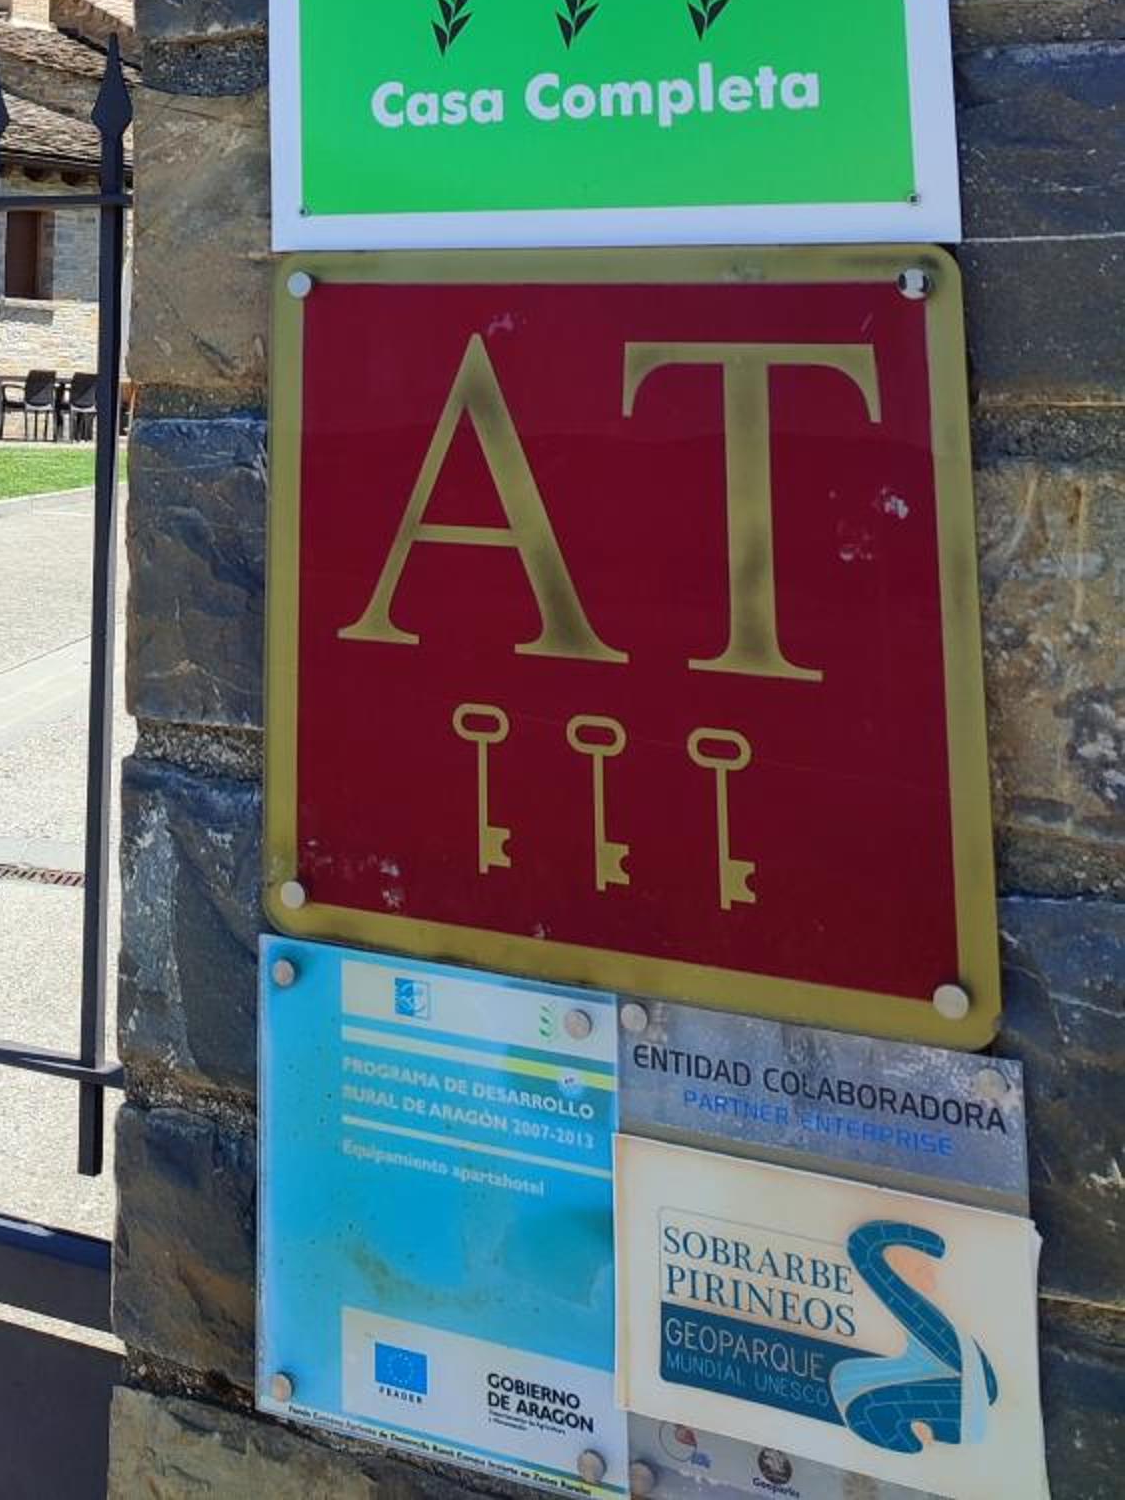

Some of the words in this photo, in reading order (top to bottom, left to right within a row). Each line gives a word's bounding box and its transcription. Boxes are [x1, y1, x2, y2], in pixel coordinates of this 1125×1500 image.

[371, 82, 504, 128] Casa
[525, 62, 820, 127] Completa
[337, 333, 882, 682] AT
[342, 1055, 441, 1091] PROGRAMA
[444, 1076, 468, 1097] DE
[472, 1082, 595, 1120] DESARROLLO
[342, 1085, 398, 1109] RURAL
[402, 1096, 426, 1115] DE
[512, 1118, 594, 1149] 2007-2013
[634, 1044, 752, 1087] ENTIDAD
[763, 1067, 1006, 1134] COLABORADORA
[684, 1090, 789, 1125] PARTNER
[801, 1113, 954, 1156] ENTERPRISE
[342, 1138, 448, 1175] Equipamiento
[663, 1226, 854, 1295] SOBRARBE
[666, 1263, 857, 1337] PIRINEOS
[665, 1317, 825, 1382] GEOPARQUE
[666, 1350, 745, 1387] MUNDIAL
[754, 1372, 830, 1407] UNESCO
[487, 1373, 580, 1409] GOBIERNO
[487, 1391, 510, 1411] DE
